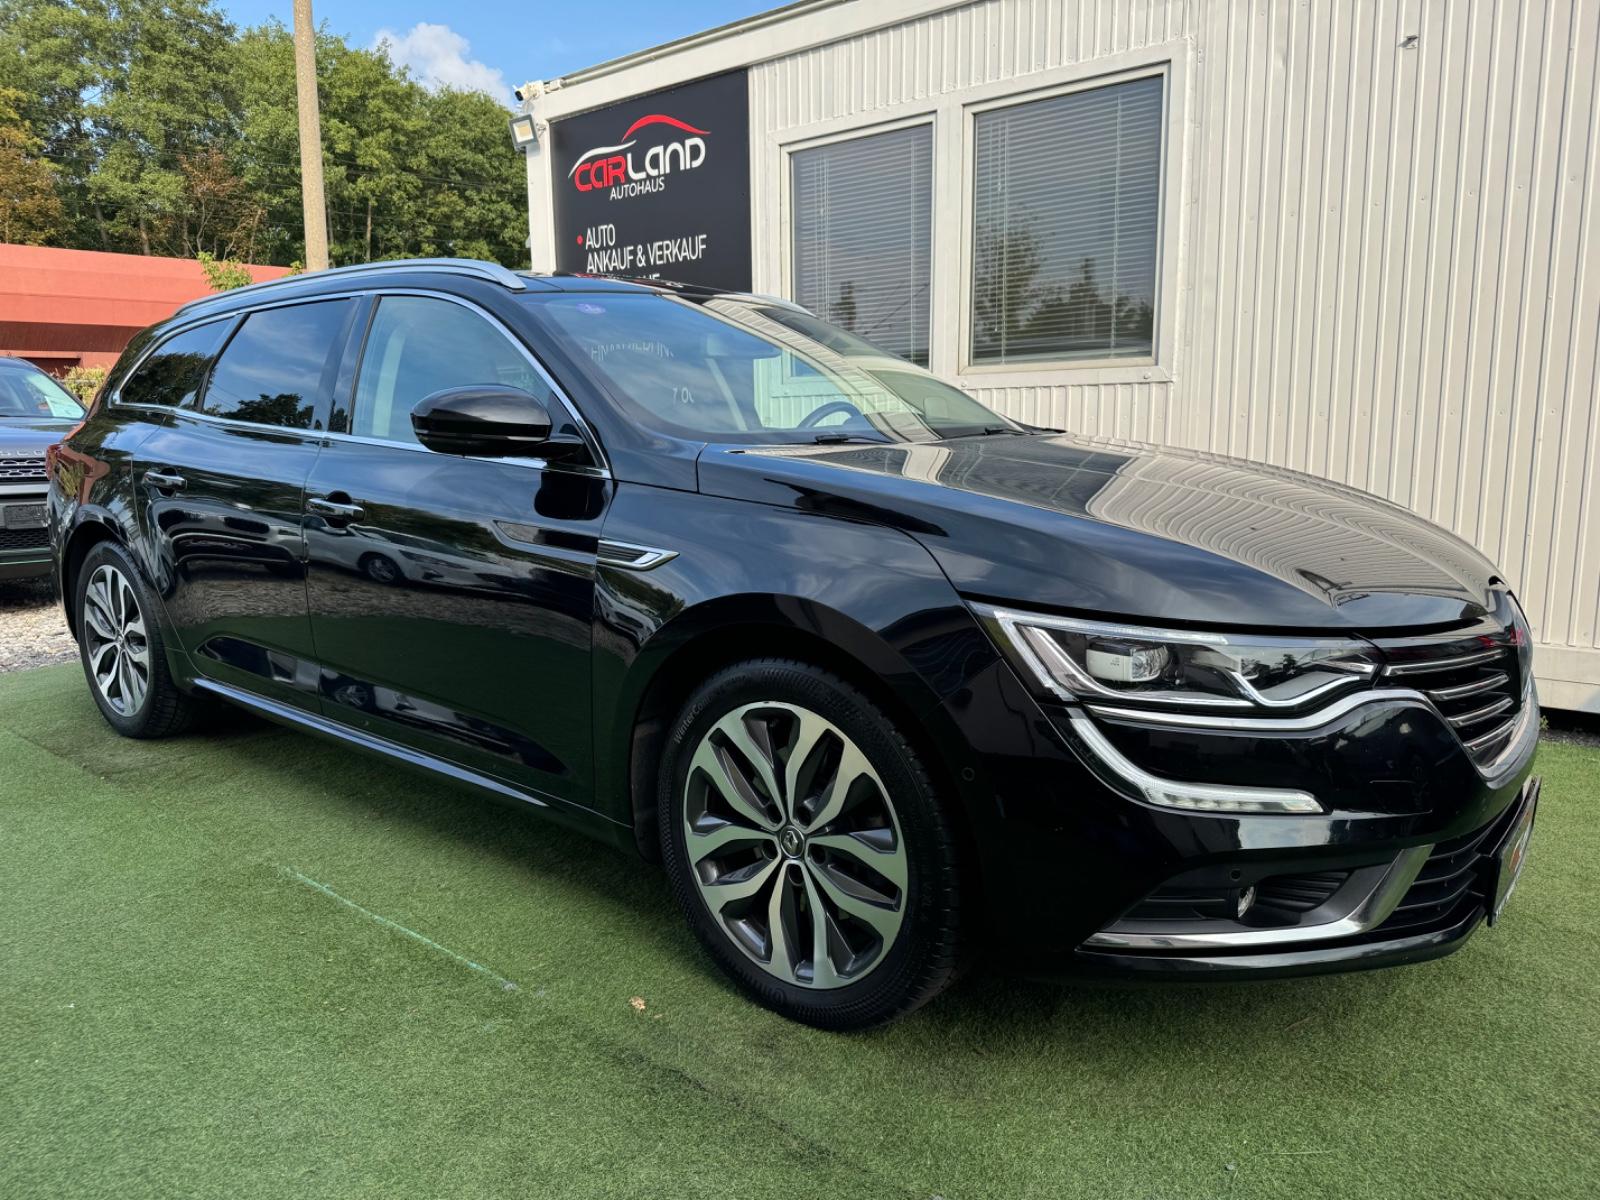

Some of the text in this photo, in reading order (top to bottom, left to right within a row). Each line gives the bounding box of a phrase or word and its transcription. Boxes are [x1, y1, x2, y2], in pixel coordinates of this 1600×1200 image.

[609, 176, 665, 201] AUTOHAUS
[585, 223, 616, 250] AUTO
[586, 233, 708, 274] ANKAUF & VERKAUF
